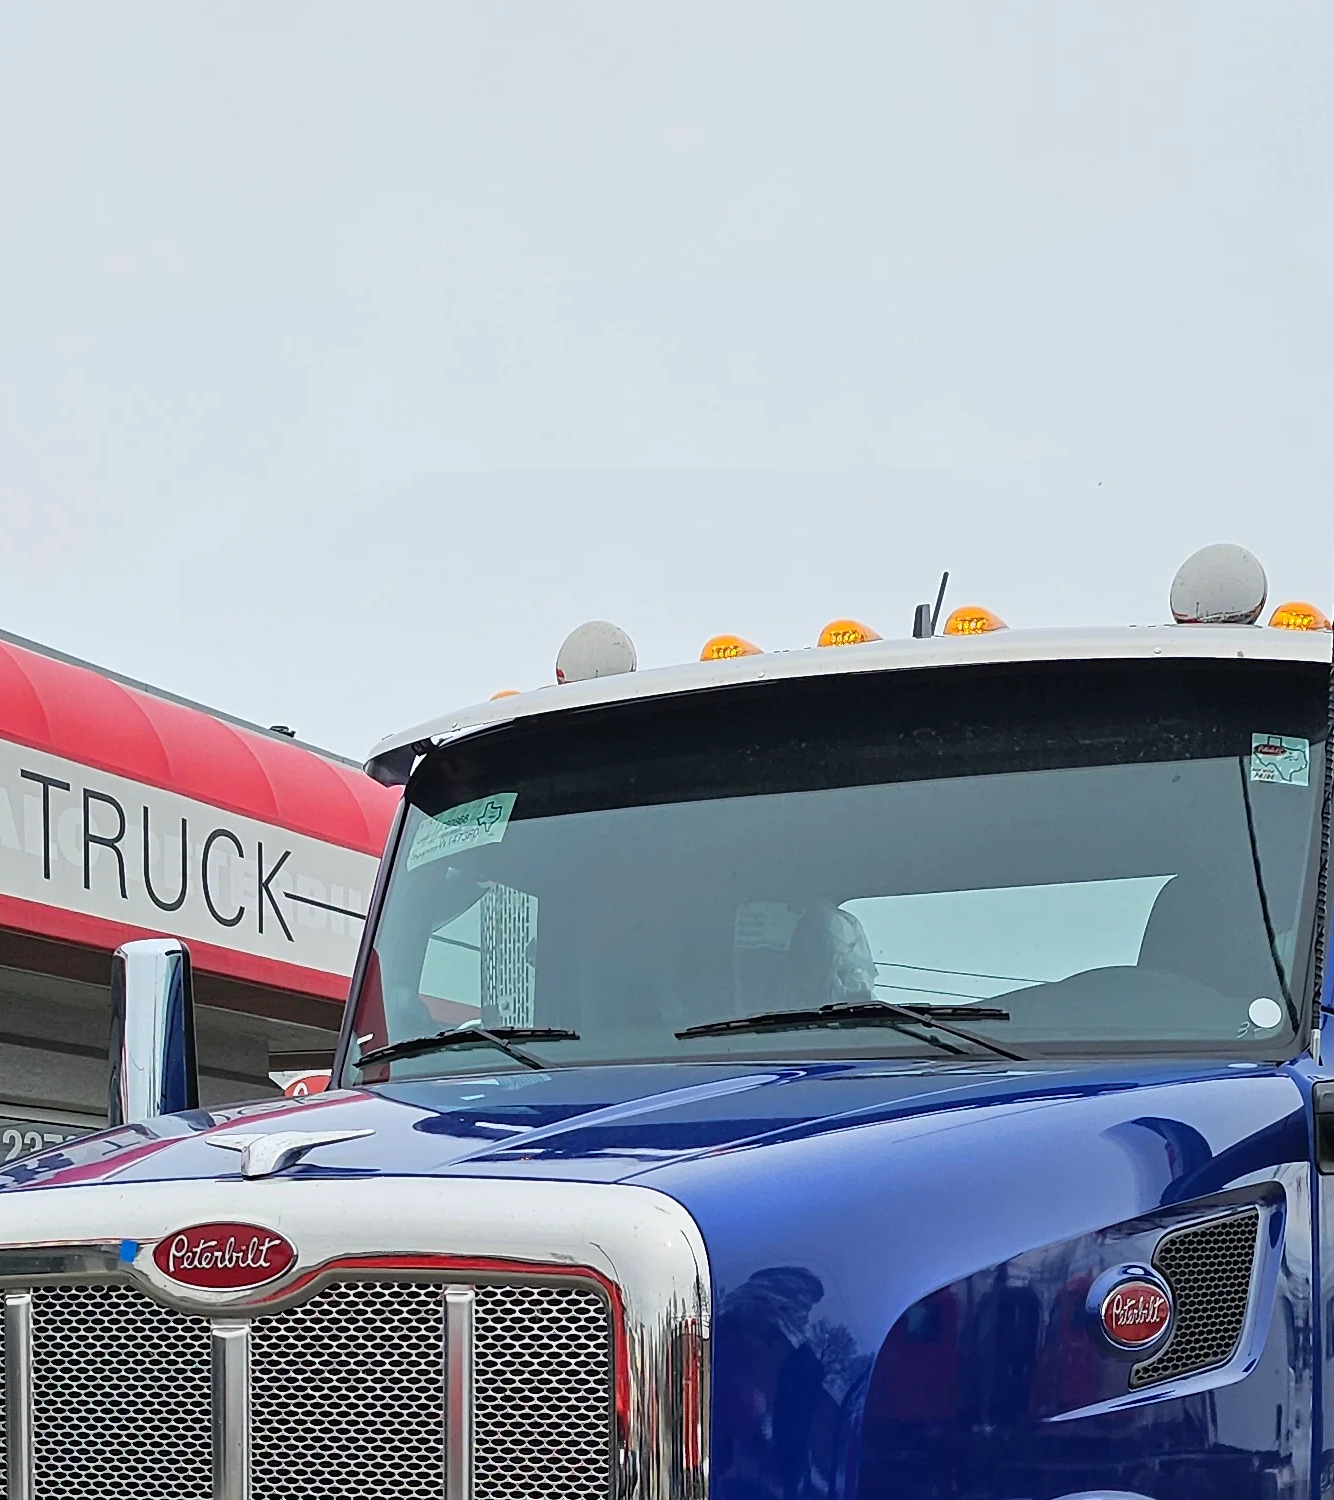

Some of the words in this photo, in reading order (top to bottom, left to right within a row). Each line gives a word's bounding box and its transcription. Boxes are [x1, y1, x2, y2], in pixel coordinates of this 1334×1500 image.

[20, 768, 295, 943] TRUCK
[168, 1234, 282, 1273] Peterbilt
[1112, 1294, 1165, 1329] Peterbilt
